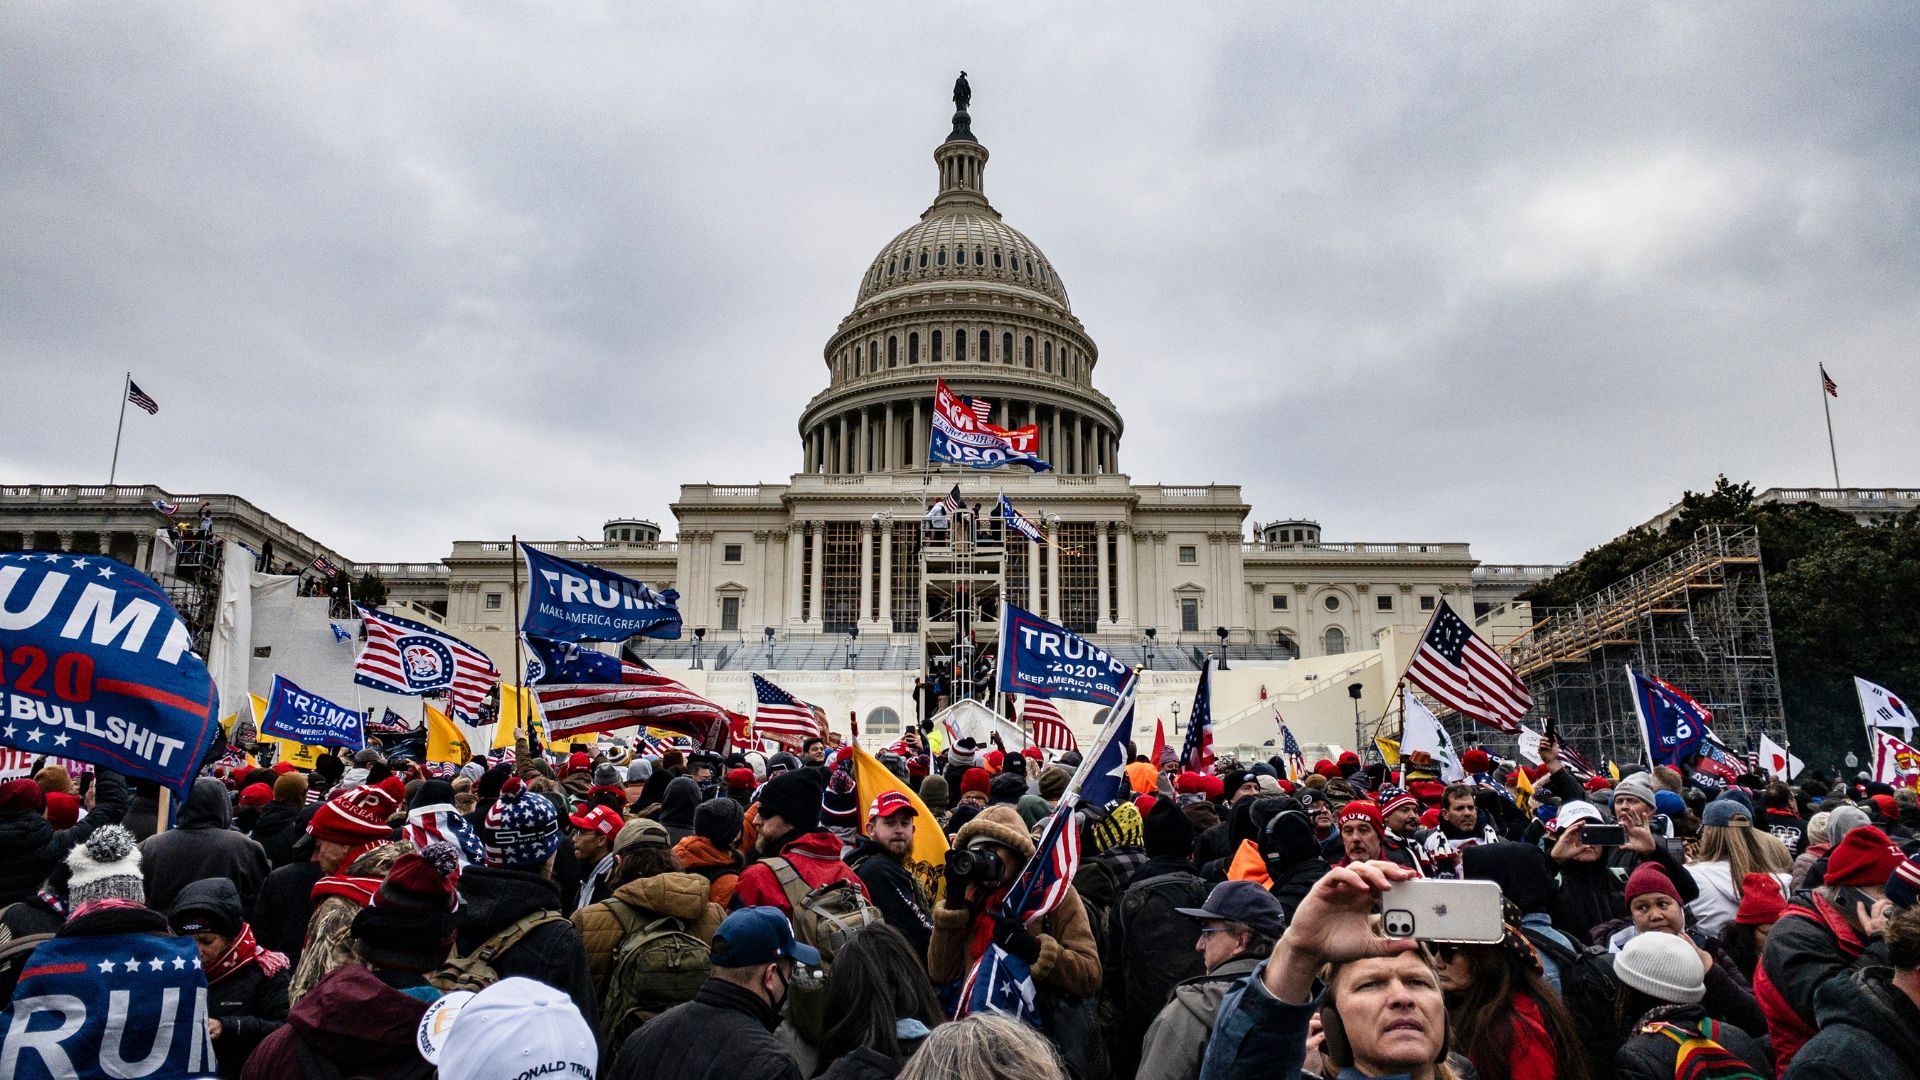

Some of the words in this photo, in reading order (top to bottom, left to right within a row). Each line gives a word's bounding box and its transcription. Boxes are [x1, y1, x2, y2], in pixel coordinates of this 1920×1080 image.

[539, 602, 564, 621] MAKE
[565, 611, 612, 628] AMERICA
[613, 617, 647, 630] GREAT
[1020, 625, 1126, 675] TRUMP
[1018, 671, 1045, 685] KEEP
[1046, 675, 1093, 689] AMERICA
[283, 687, 358, 731] TRUMP
[10, 694, 185, 767] BULLSHIT
[274, 719, 294, 731] KEEP
[294, 727, 328, 737] AMERICA
[1339, 811, 1371, 825] TRUMP
